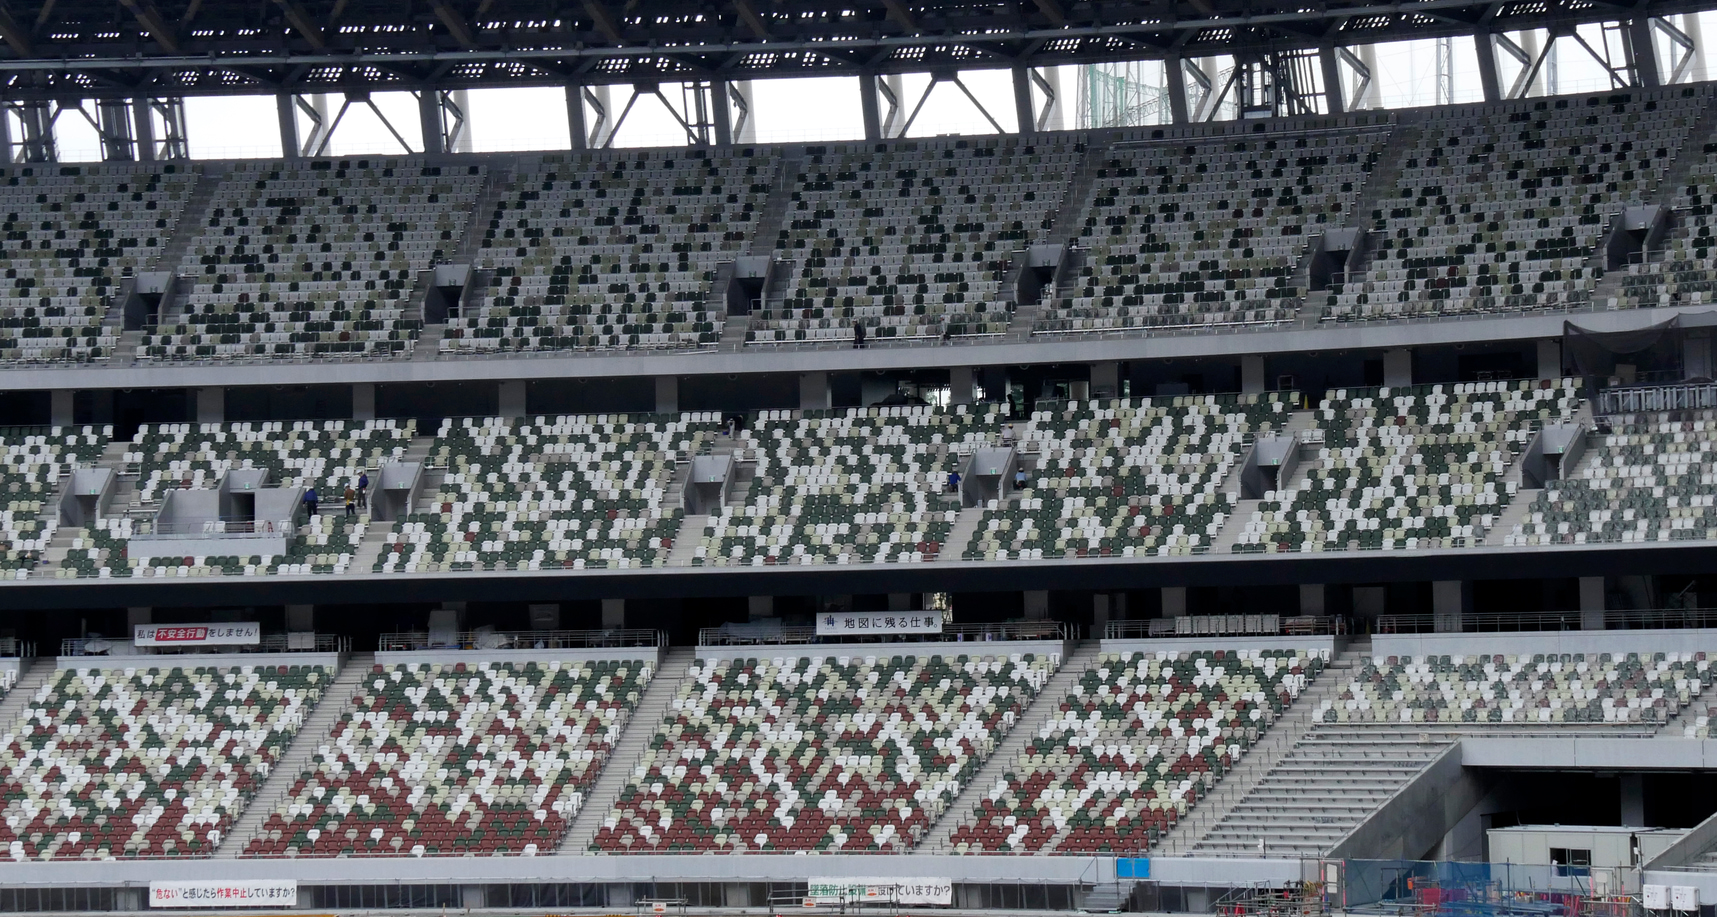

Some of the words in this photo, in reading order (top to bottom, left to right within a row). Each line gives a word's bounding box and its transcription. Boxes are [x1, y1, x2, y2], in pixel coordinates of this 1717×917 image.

[844, 616, 938, 629] 地図に残る仕事。
